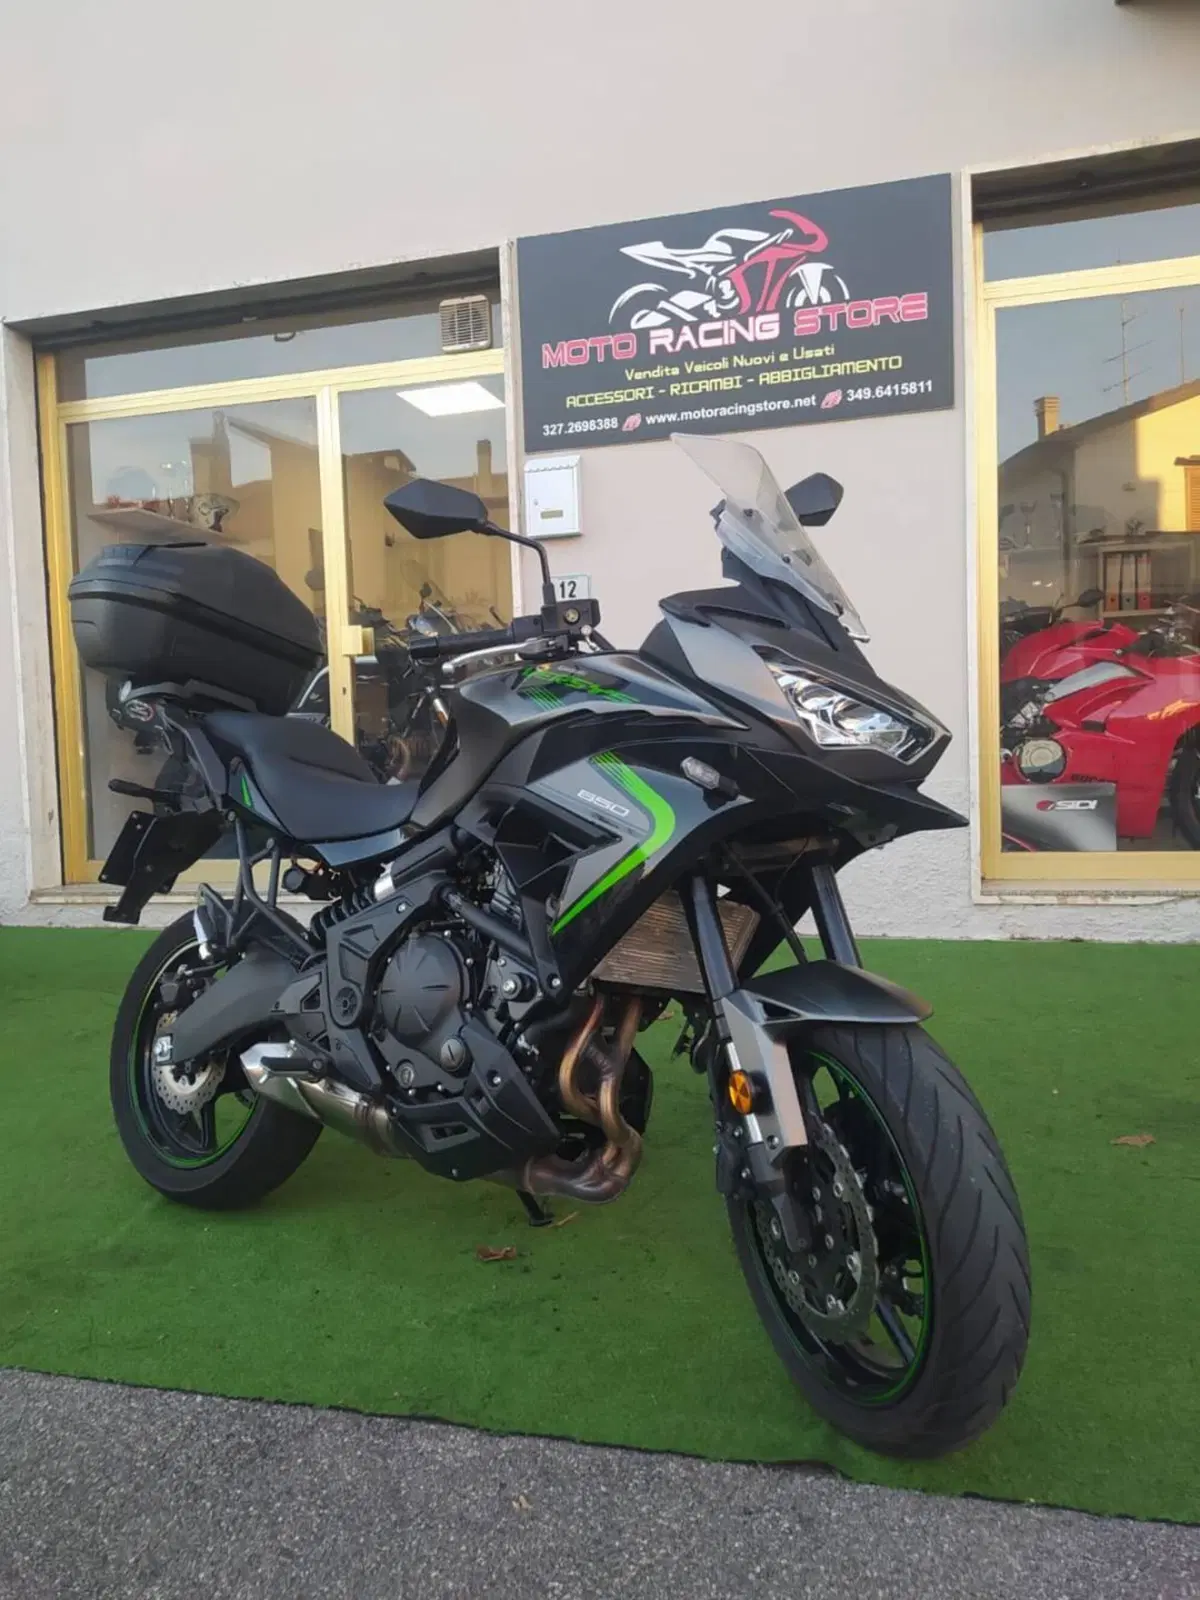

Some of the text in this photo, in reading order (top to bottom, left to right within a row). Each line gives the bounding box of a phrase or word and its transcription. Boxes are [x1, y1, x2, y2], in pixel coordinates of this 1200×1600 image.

[542, 292, 928, 368] MOTO RACING STORE
[566, 386, 655, 408] ACCESSORI
[670, 375, 743, 396] RICAMBI
[759, 355, 902, 386] ABBIGLIAMENTO
[625, 344, 835, 381] Vendita Veicoli Nuovi e Usati
[542, 380, 933, 436] 327.2698388 www.motoracingstore.net 349.6415811
[560, 580, 577, 599] 12
[577, 788, 630, 818] 650
